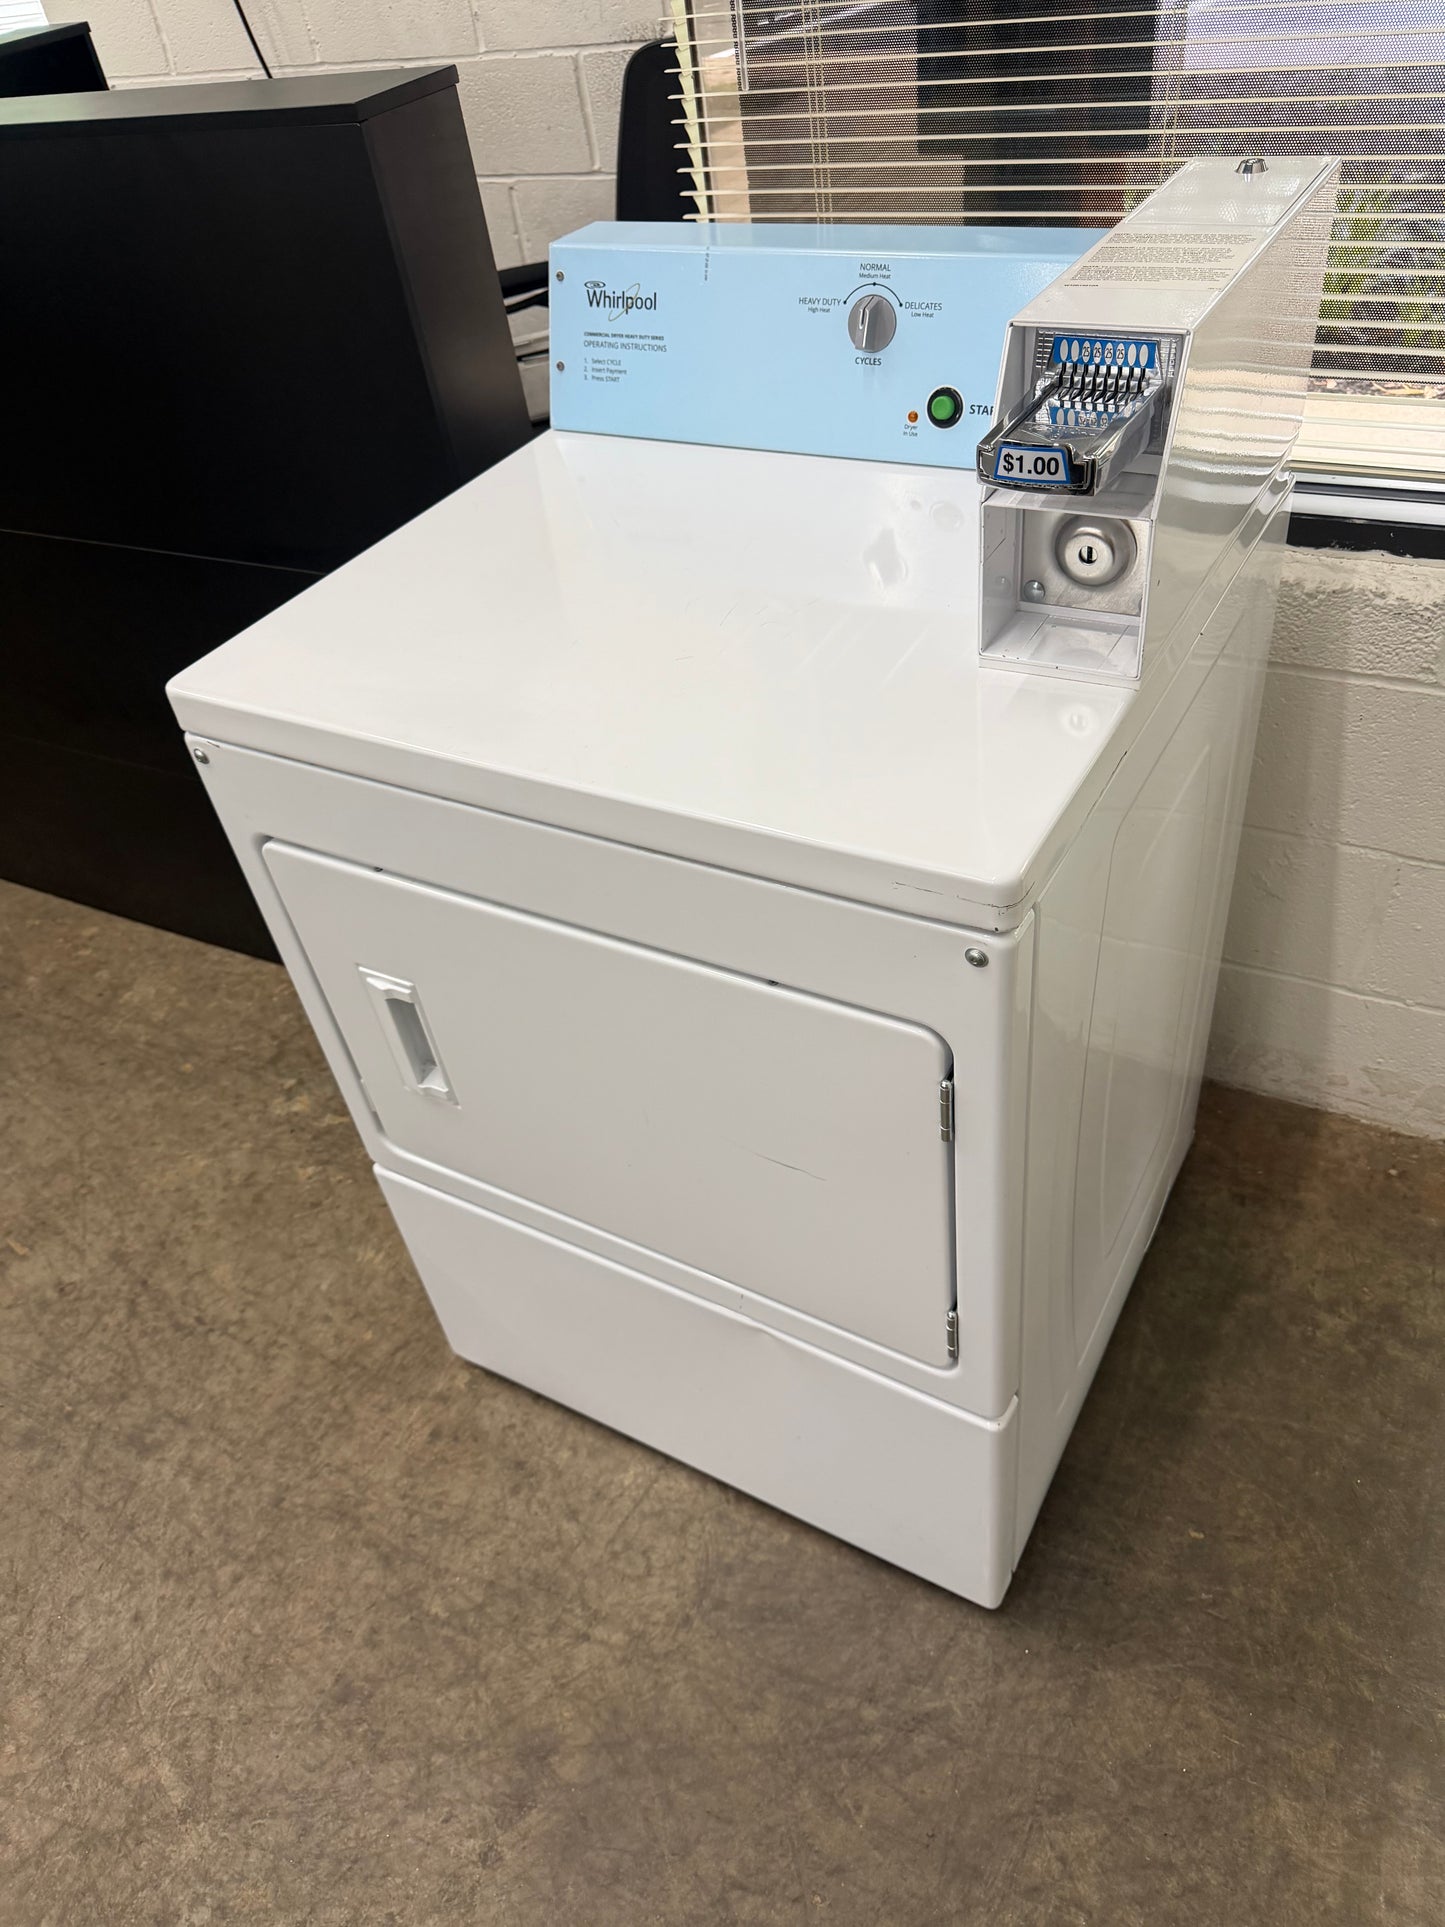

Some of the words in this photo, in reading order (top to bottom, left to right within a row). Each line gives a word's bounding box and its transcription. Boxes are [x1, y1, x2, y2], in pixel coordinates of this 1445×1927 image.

[860, 263, 891, 271] NORMAL
[586, 289, 657, 315] Whirlpool
[798, 297, 821, 305] HEAVY
[904, 301, 943, 311] DELICATES
[584, 340, 619, 350] OPERATING
[620, 342, 667, 352] INSTRUCTIONS
[1083, 346, 1091, 357] 25
[1094, 346, 1102, 357] 25
[1105, 347, 1114, 359] 25
[1117, 348, 1125, 360] 25
[855, 357, 882, 366] CYCLES
[1002, 452, 1060, 475] $1.00
